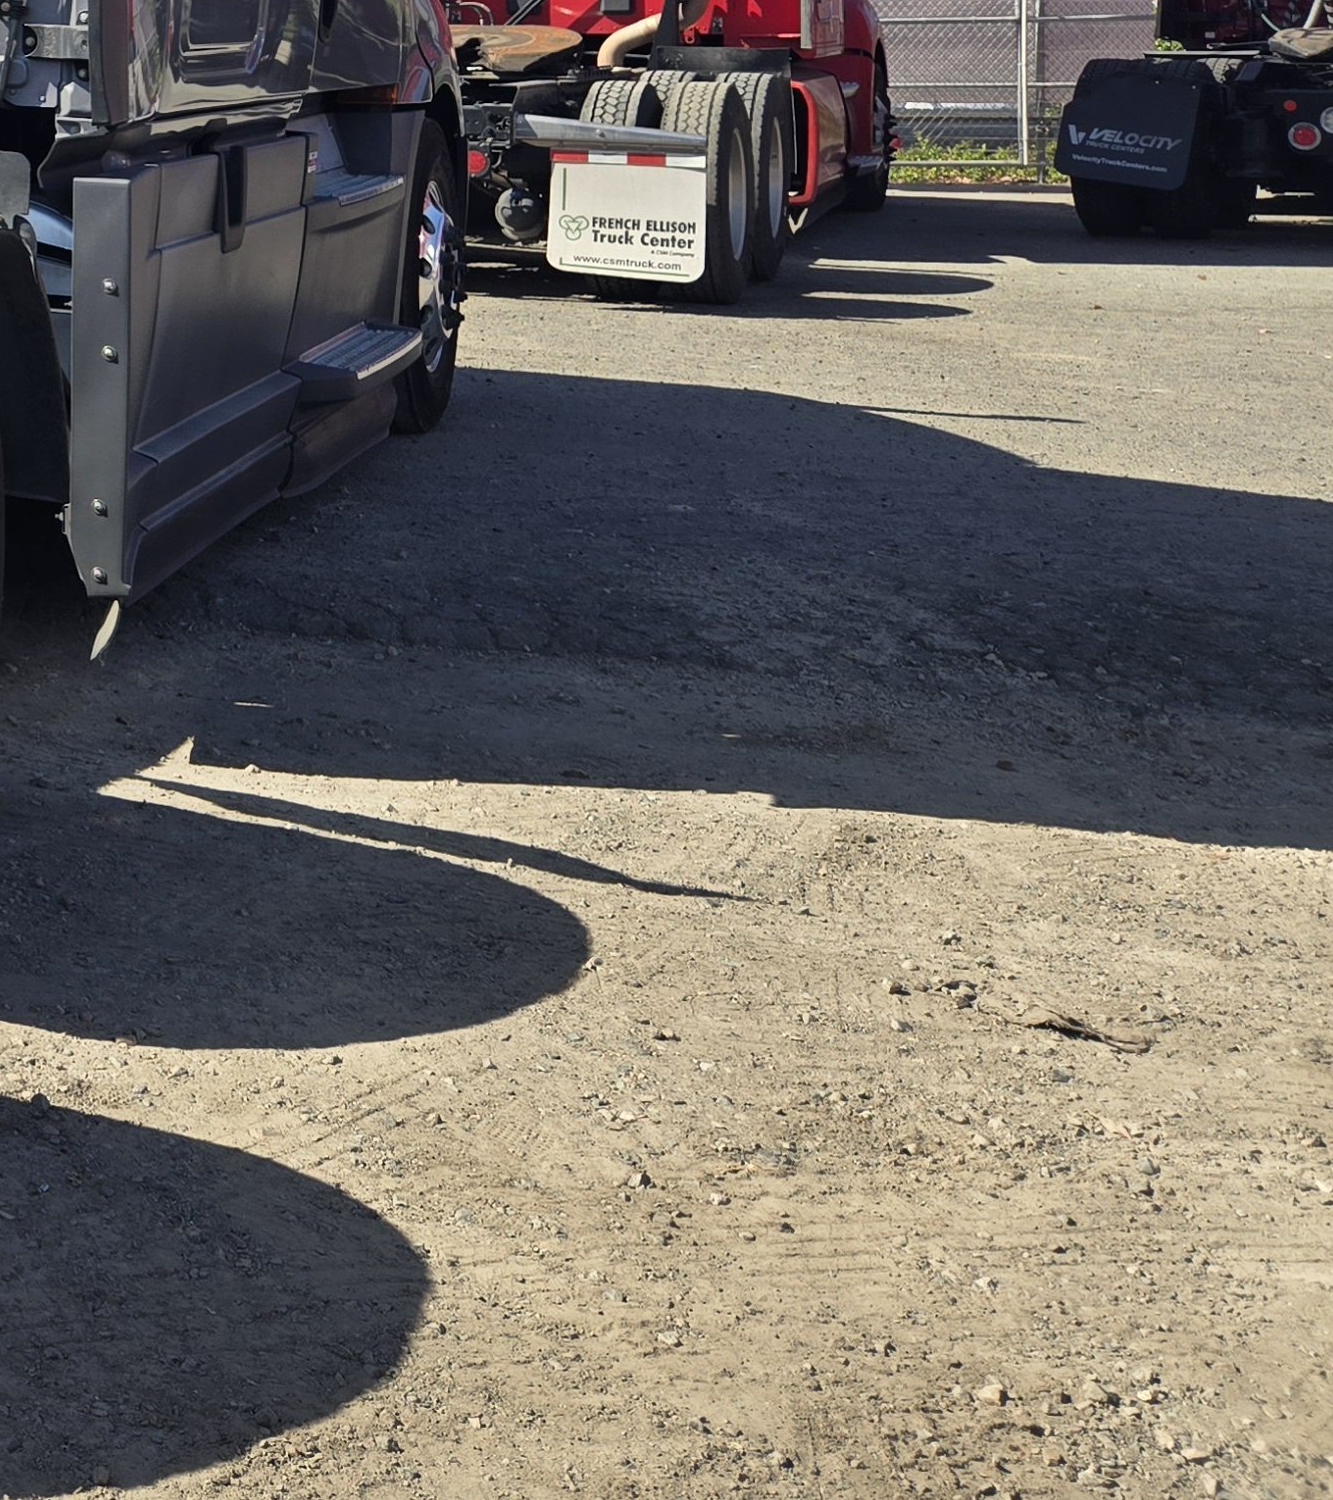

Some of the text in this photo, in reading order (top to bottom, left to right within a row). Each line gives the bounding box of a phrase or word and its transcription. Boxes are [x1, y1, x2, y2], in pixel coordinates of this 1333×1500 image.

[1085, 140, 1145, 154] TRUCK CENTERS
[1089, 127, 1182, 151] VELOCITY
[1072, 153, 1168, 173] VelocityTruckCenters.com
[591, 216, 697, 235] FRENCH ELLISON
[591, 229, 695, 250] Truck Center
[573, 254, 682, 272] www.csmtruck.com
